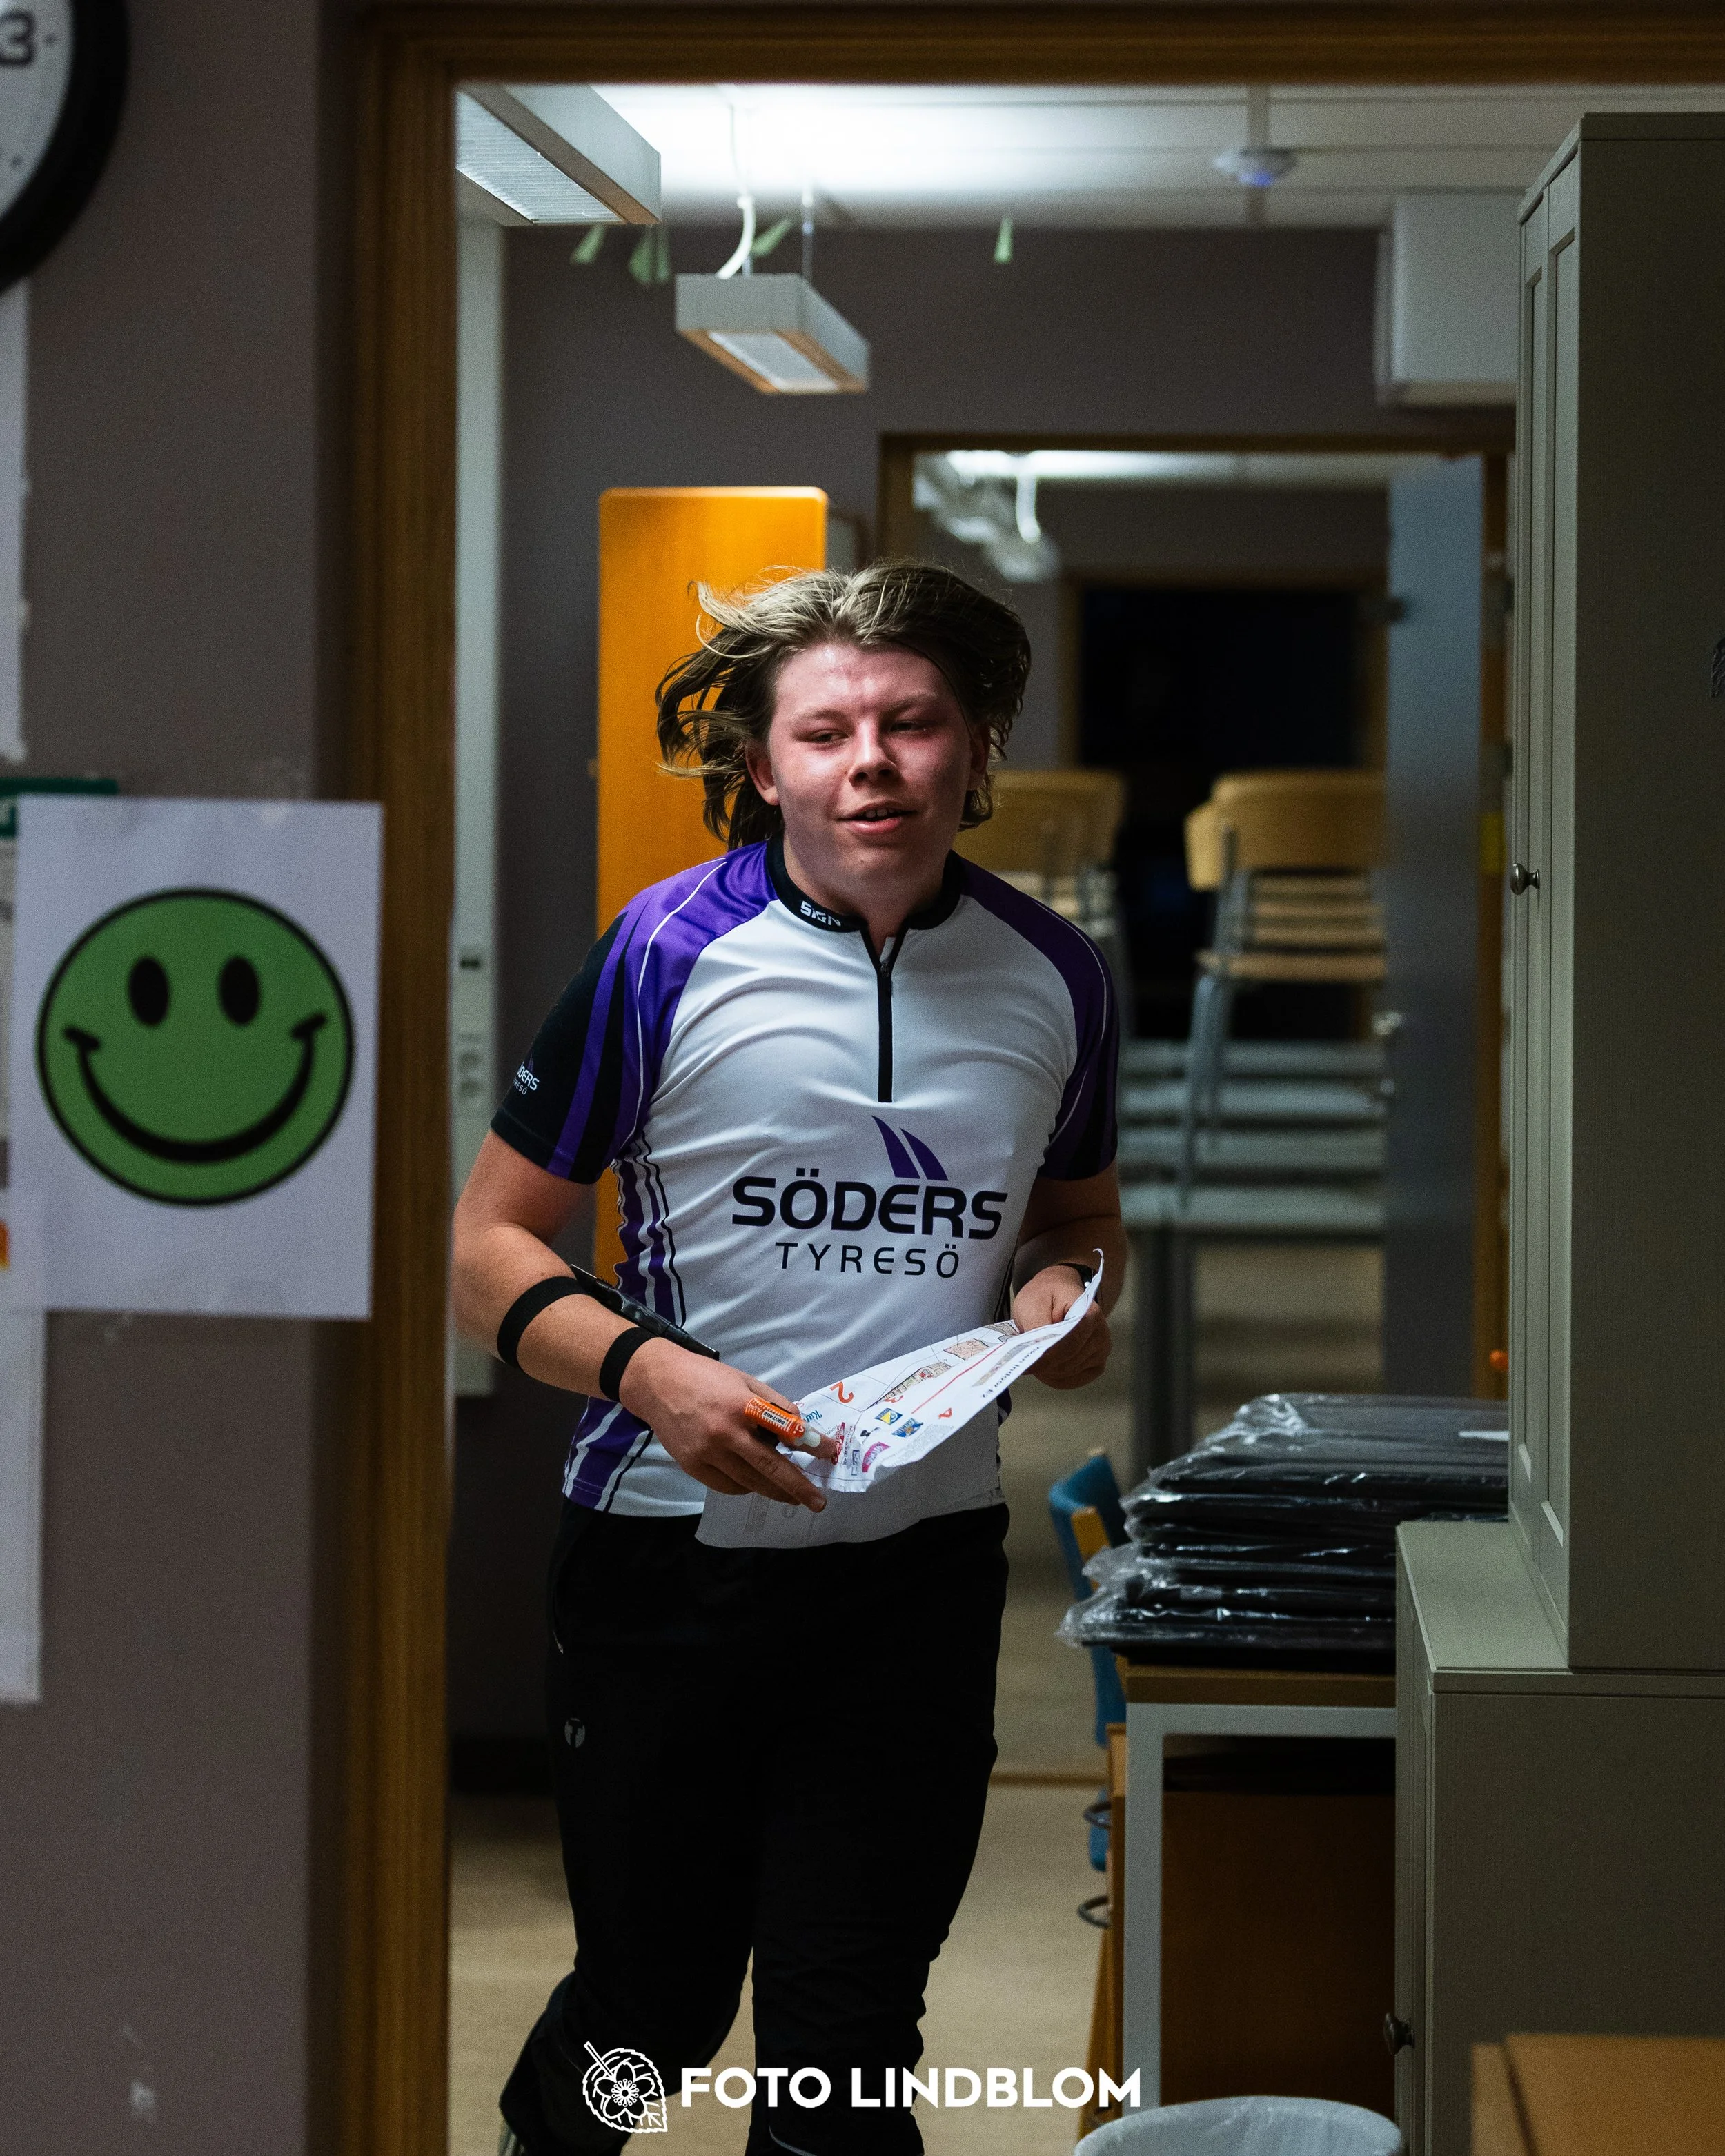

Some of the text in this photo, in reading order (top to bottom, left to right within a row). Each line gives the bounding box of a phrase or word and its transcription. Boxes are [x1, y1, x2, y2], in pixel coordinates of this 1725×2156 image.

[517, 1061, 540, 1091] DERS
[732, 1167, 1008, 1240] SÖDERS
[775, 1242, 960, 1278] TYRESÖ
[829, 1381, 854, 1403] 2
[762, 1410, 786, 1426] 8007462
